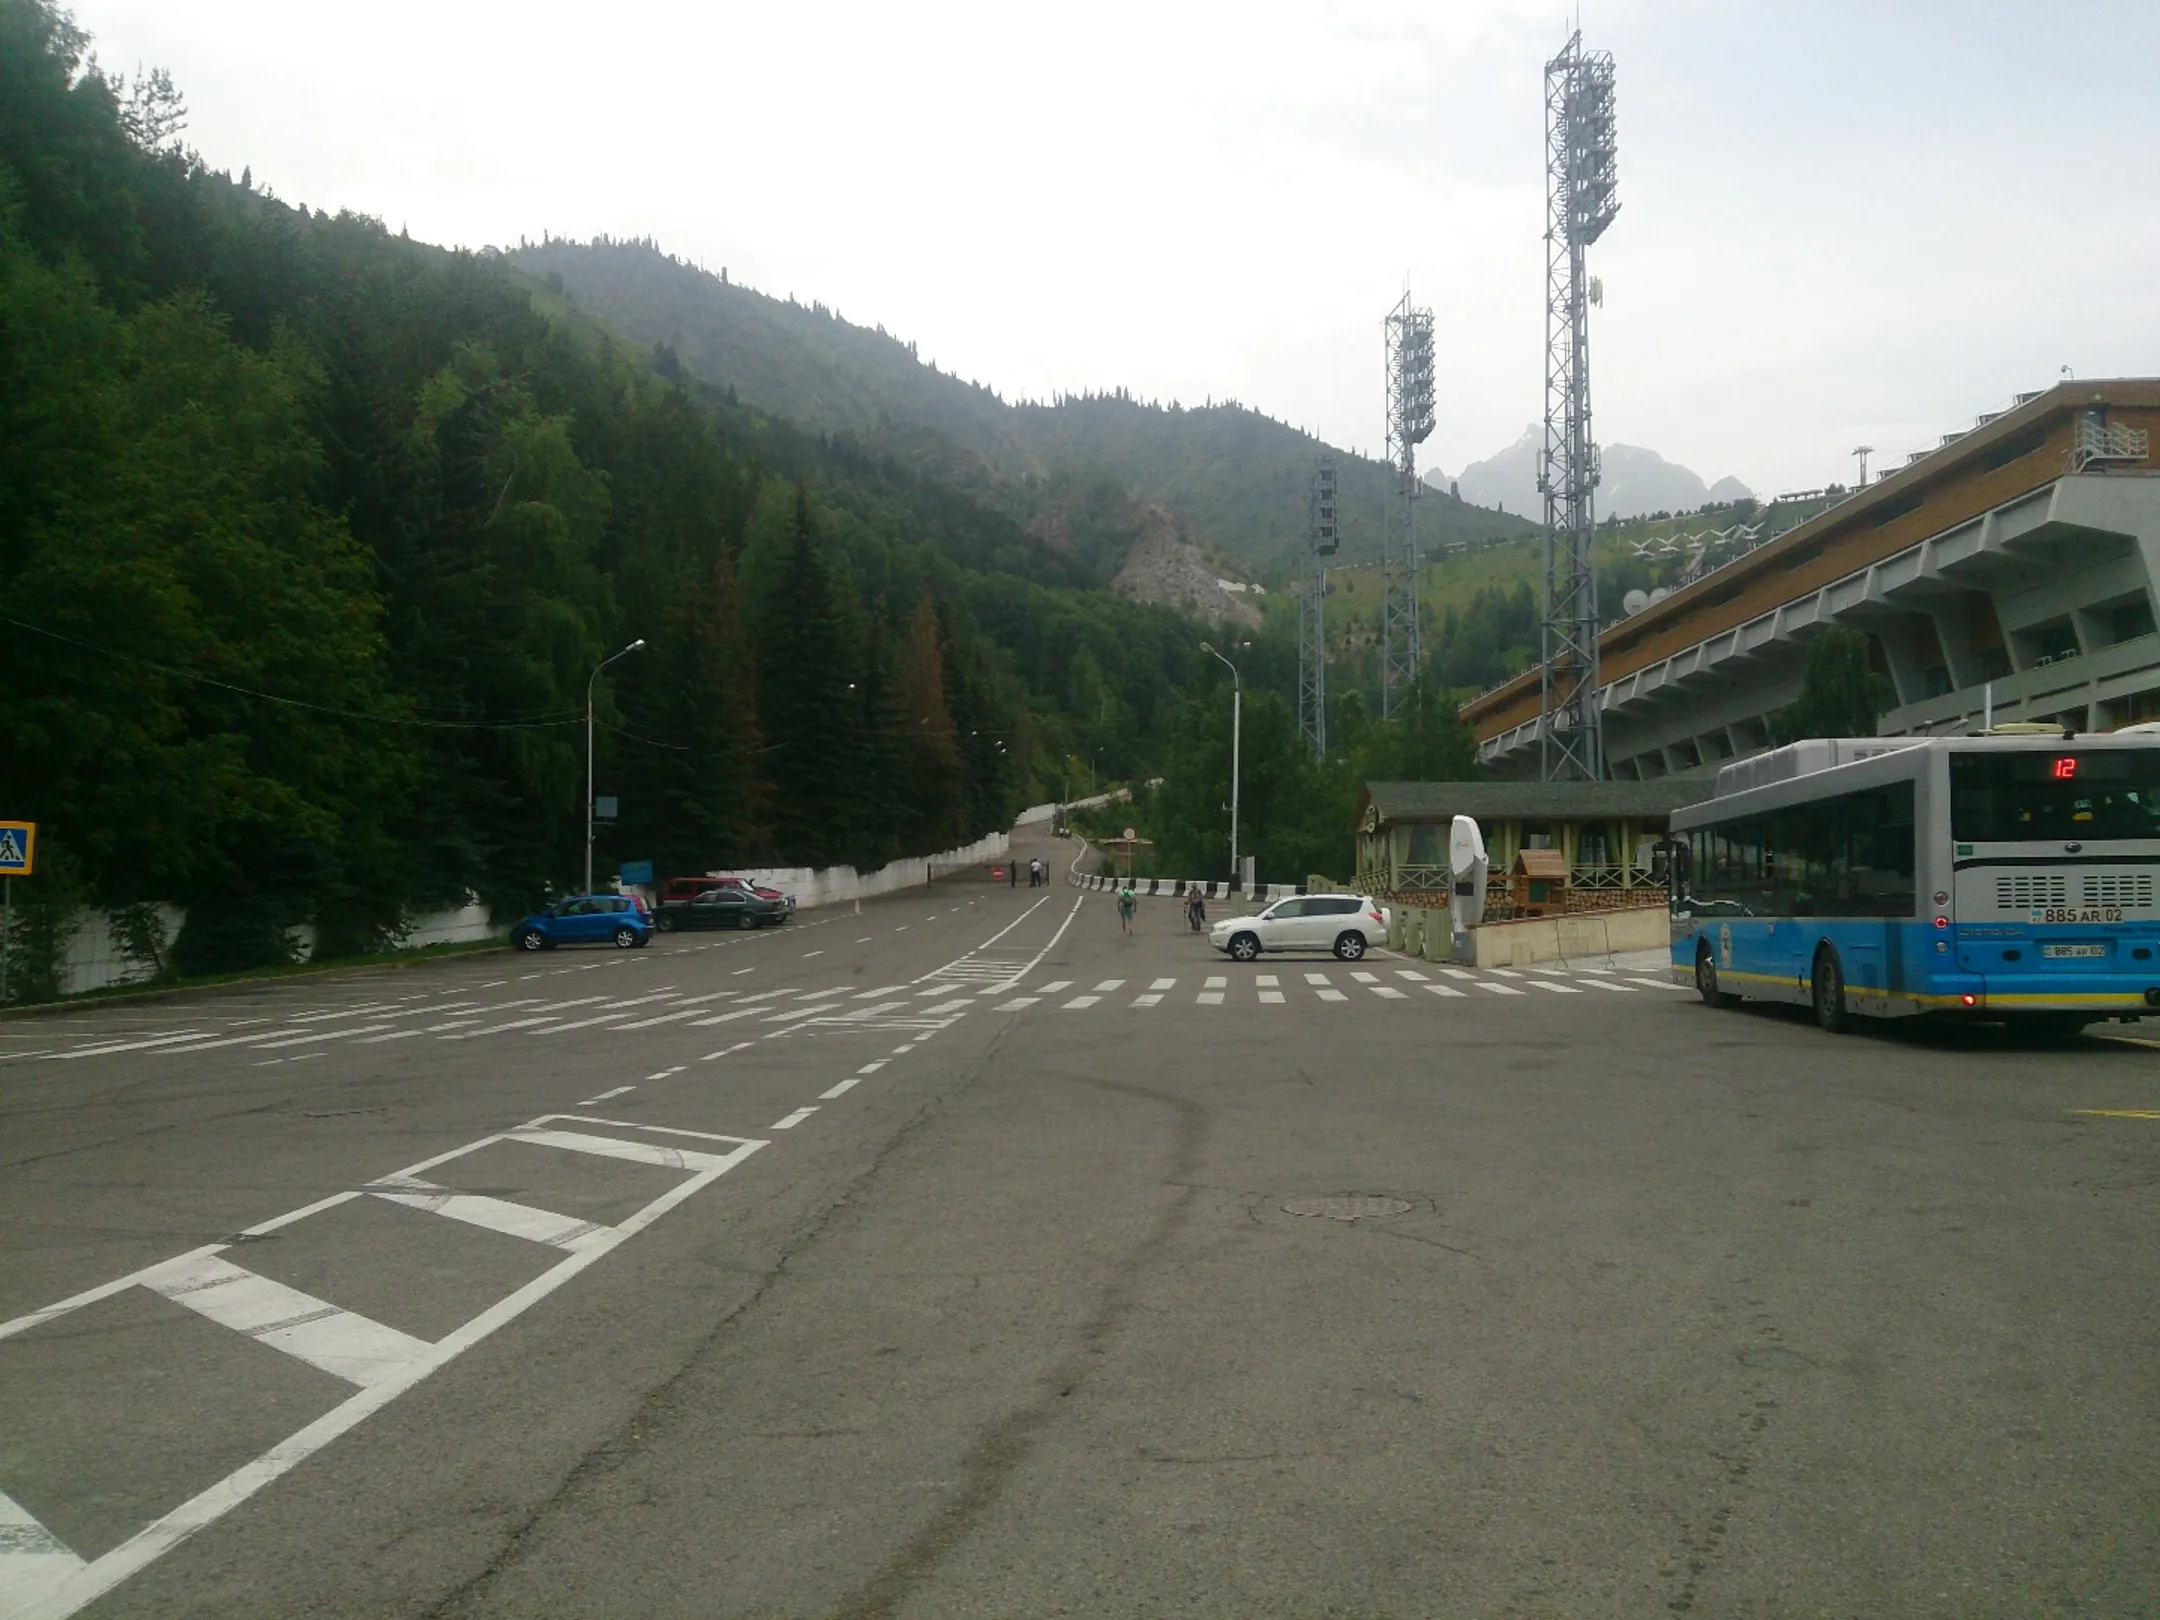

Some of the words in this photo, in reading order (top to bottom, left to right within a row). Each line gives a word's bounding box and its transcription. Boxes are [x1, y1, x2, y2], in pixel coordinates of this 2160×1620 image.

[2055, 758, 2076, 777] 12
[2045, 909, 2077, 922] 885
[2080, 910, 2101, 922] AR
[2105, 909, 2122, 921] 02
[2054, 946, 2073, 956] 885
[2090, 946, 2104, 956] 02
